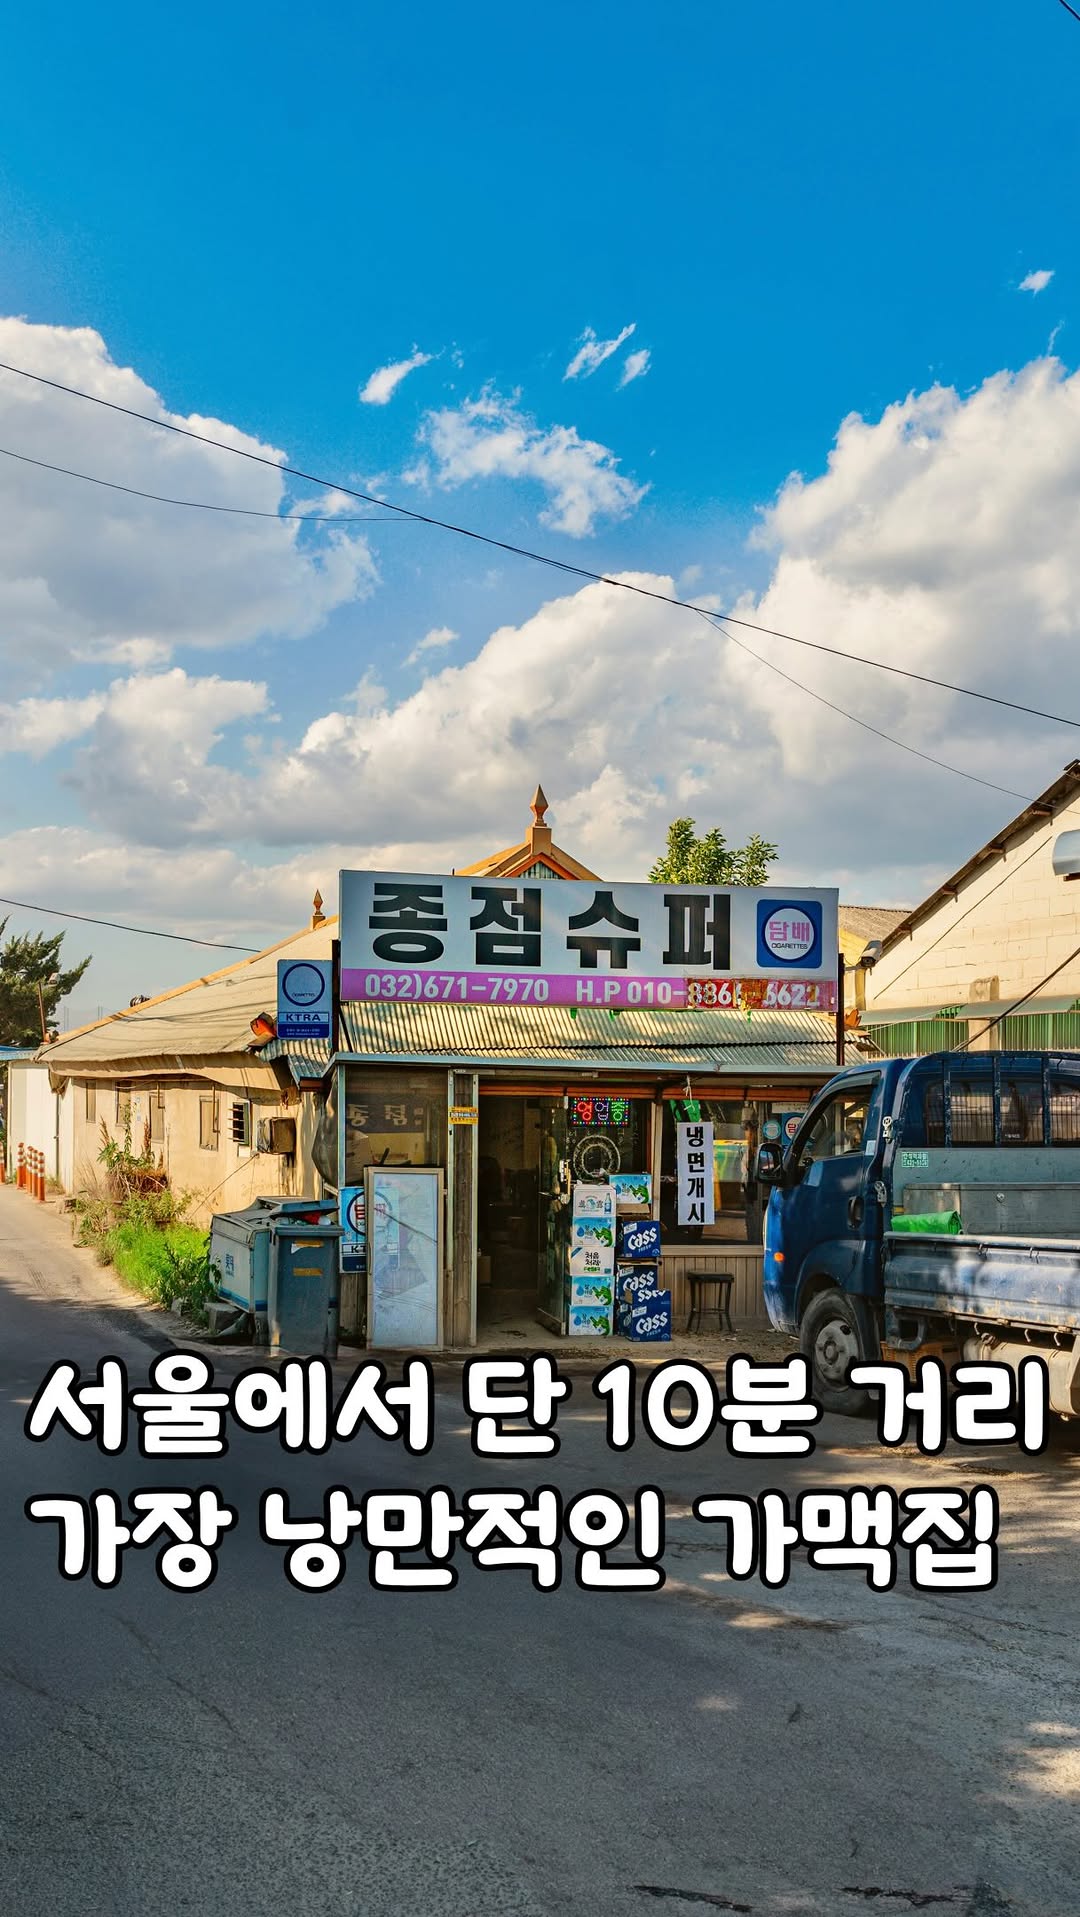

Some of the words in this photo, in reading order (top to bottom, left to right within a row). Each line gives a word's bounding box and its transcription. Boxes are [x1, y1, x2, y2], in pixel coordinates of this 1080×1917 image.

[369, 882, 731, 970] 종점슈퍼
[769, 921, 810, 942] 담배
[365, 973, 549, 1001] 032)671-7970
[576, 979, 620, 1003] H.P
[286, 1013, 321, 1022] KTRA
[577, 1101, 625, 1121] 영업중
[686, 1126, 705, 1224] 냉면개시
